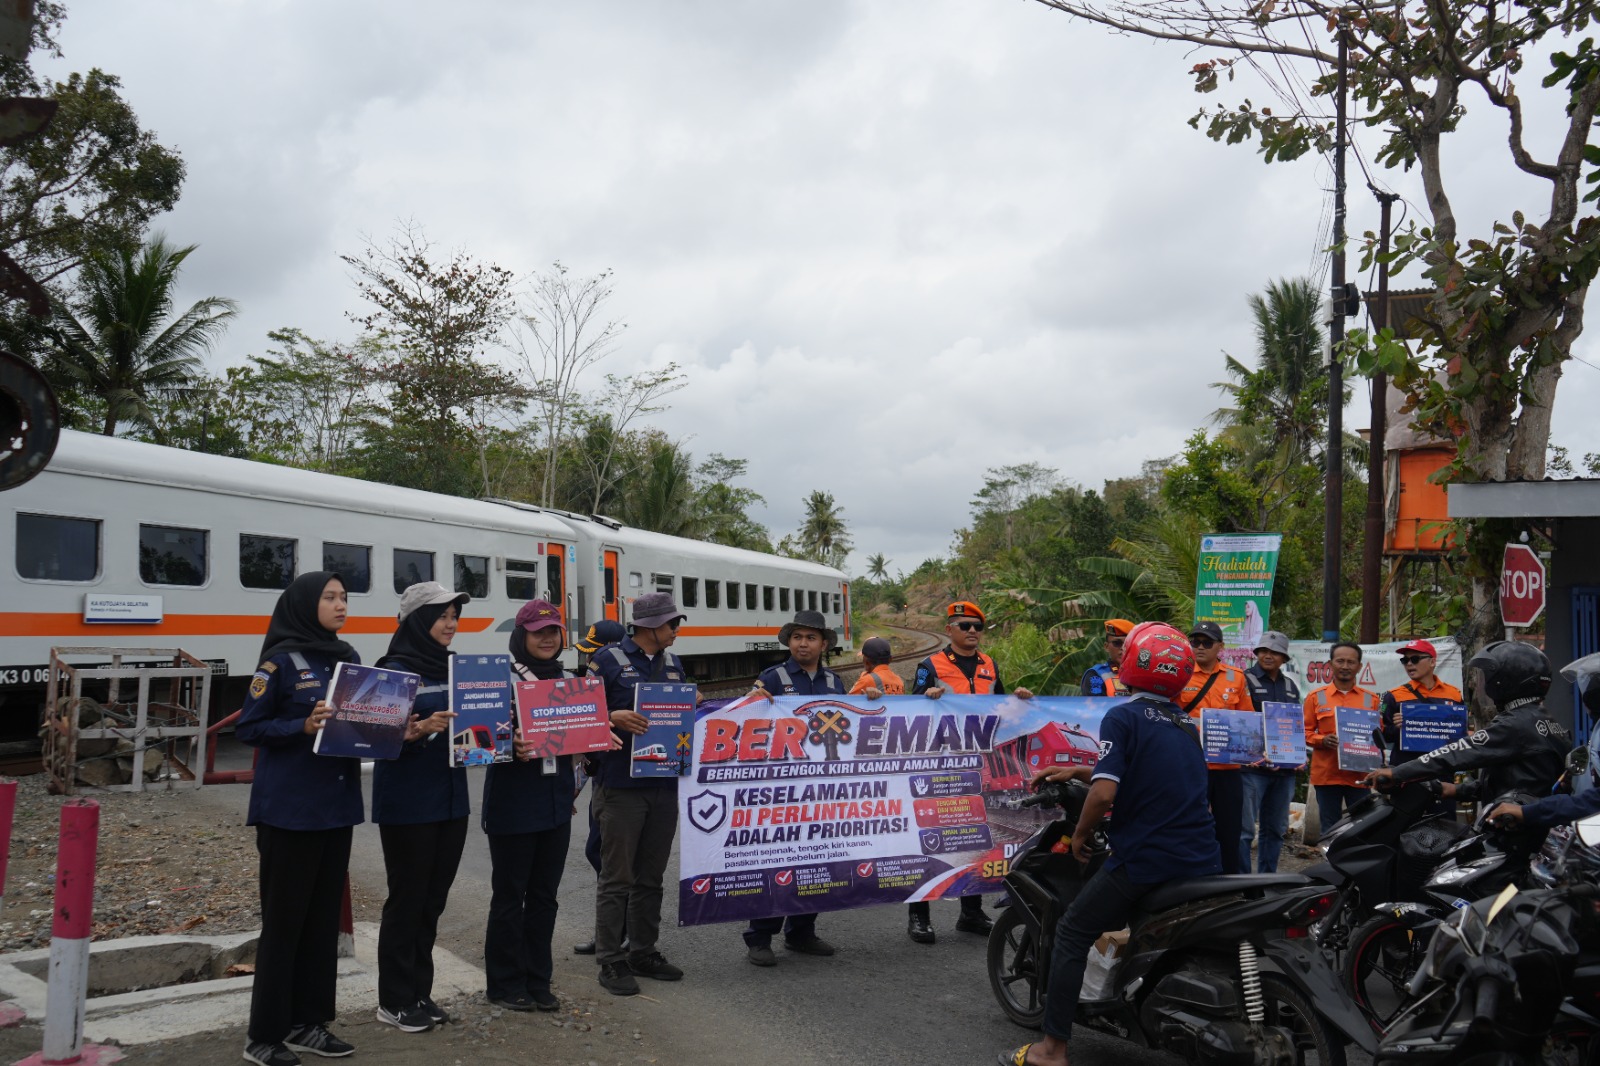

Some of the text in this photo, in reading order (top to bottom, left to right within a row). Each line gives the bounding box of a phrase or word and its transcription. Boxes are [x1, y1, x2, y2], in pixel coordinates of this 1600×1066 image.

[1202, 556, 1267, 572] Hadirilah
[1500, 570, 1540, 599] STOP
[0, 670, 18, 684] K3
[22, 670, 30, 683] 0
[341, 701, 368, 711] JANGAN
[533, 704, 596, 717] STOP NEROBOS!
[706, 757, 978, 781] BERHENTI TENGOK KIRI KANAN AMAN JALAN
[734, 781, 888, 806] KESELAMATAN
[731, 799, 902, 828] DI PERLINTASAN
[724, 817, 908, 847] ADALAH PRIORITAS!
[724, 849, 759, 859] Berhenti
[760, 846, 796, 856] sejenak,
[798, 844, 829, 854] tengok
[724, 860, 759, 869] pastikan
[787, 852, 825, 862] sebelum
[827, 851, 850, 859] jalan.
